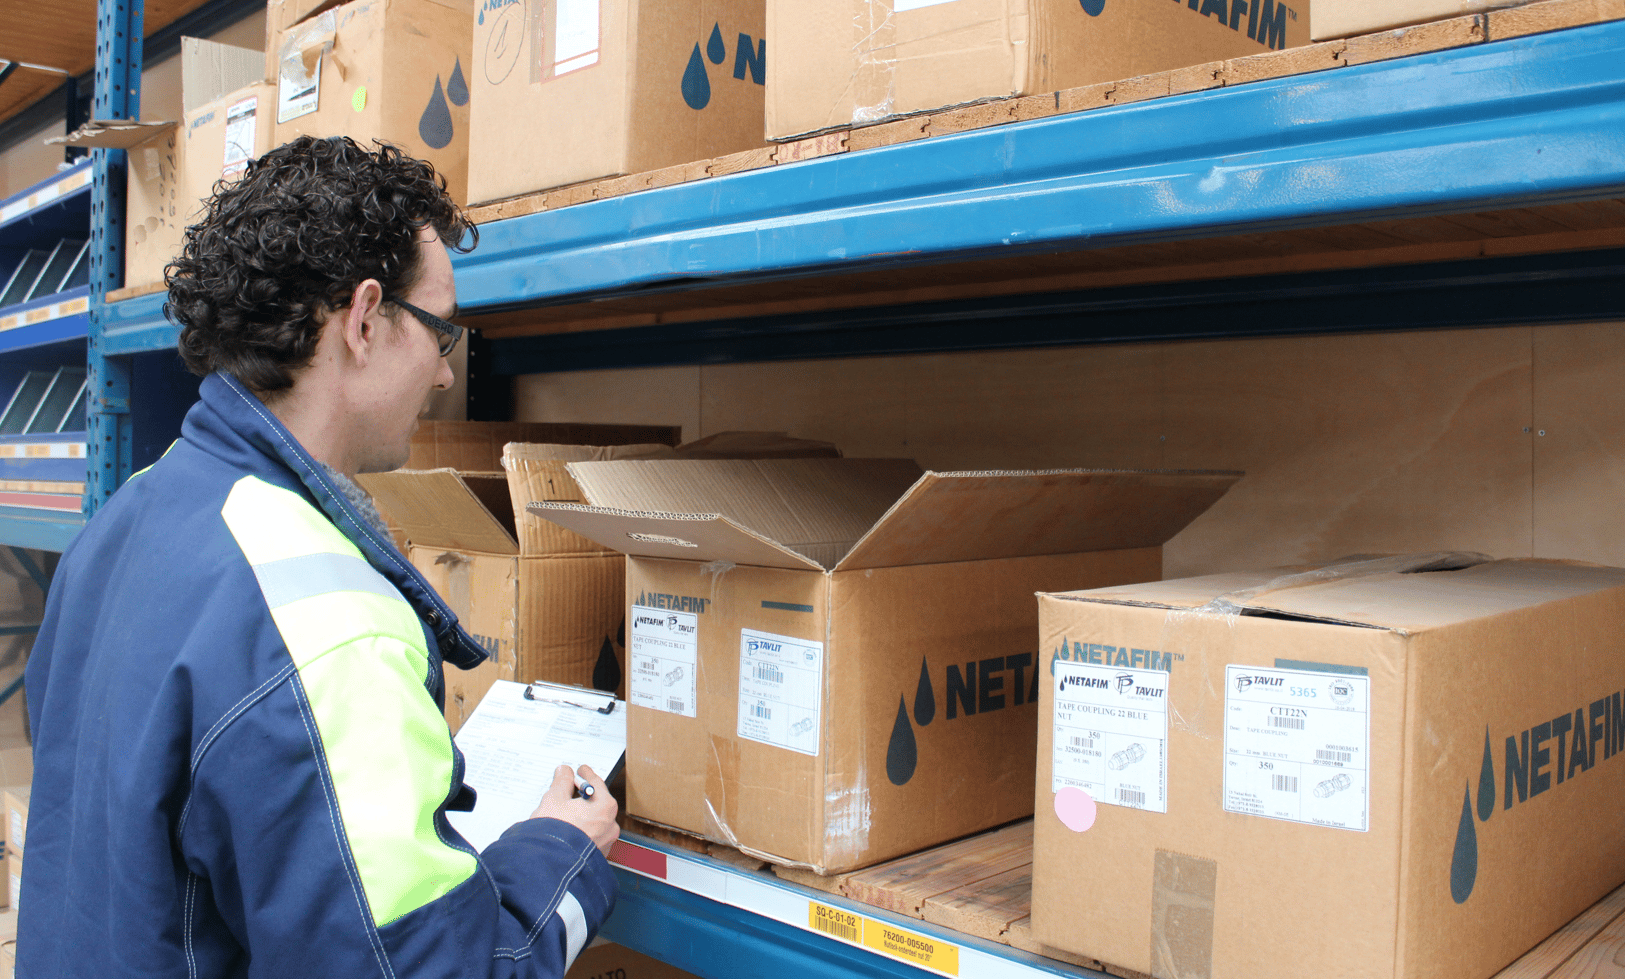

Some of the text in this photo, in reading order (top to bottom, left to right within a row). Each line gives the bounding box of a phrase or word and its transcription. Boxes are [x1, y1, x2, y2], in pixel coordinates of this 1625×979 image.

[639, 616, 664, 627] NETAFIM
[678, 624, 695, 634] TAVLIT
[760, 641, 782, 653] TAVLIT
[1068, 675, 1108, 689] NETAFIM
[1135, 686, 1164, 697] TAVLIT
[1253, 675, 1285, 687] TAVLIT
[1290, 686, 1317, 698] 5365
[1057, 712, 1072, 721] NUT
[1058, 702, 1149, 721] TAPE COUPLING 22 BLUE
[1270, 706, 1308, 718] CTT22N
[1088, 730, 1101, 740] 350
[1261, 728, 1289, 737] COUPLING
[1258, 761, 1274, 771] 350
[816, 905, 856, 927] SQ-C-01-02
[883, 929, 934, 954] 76200-005500
